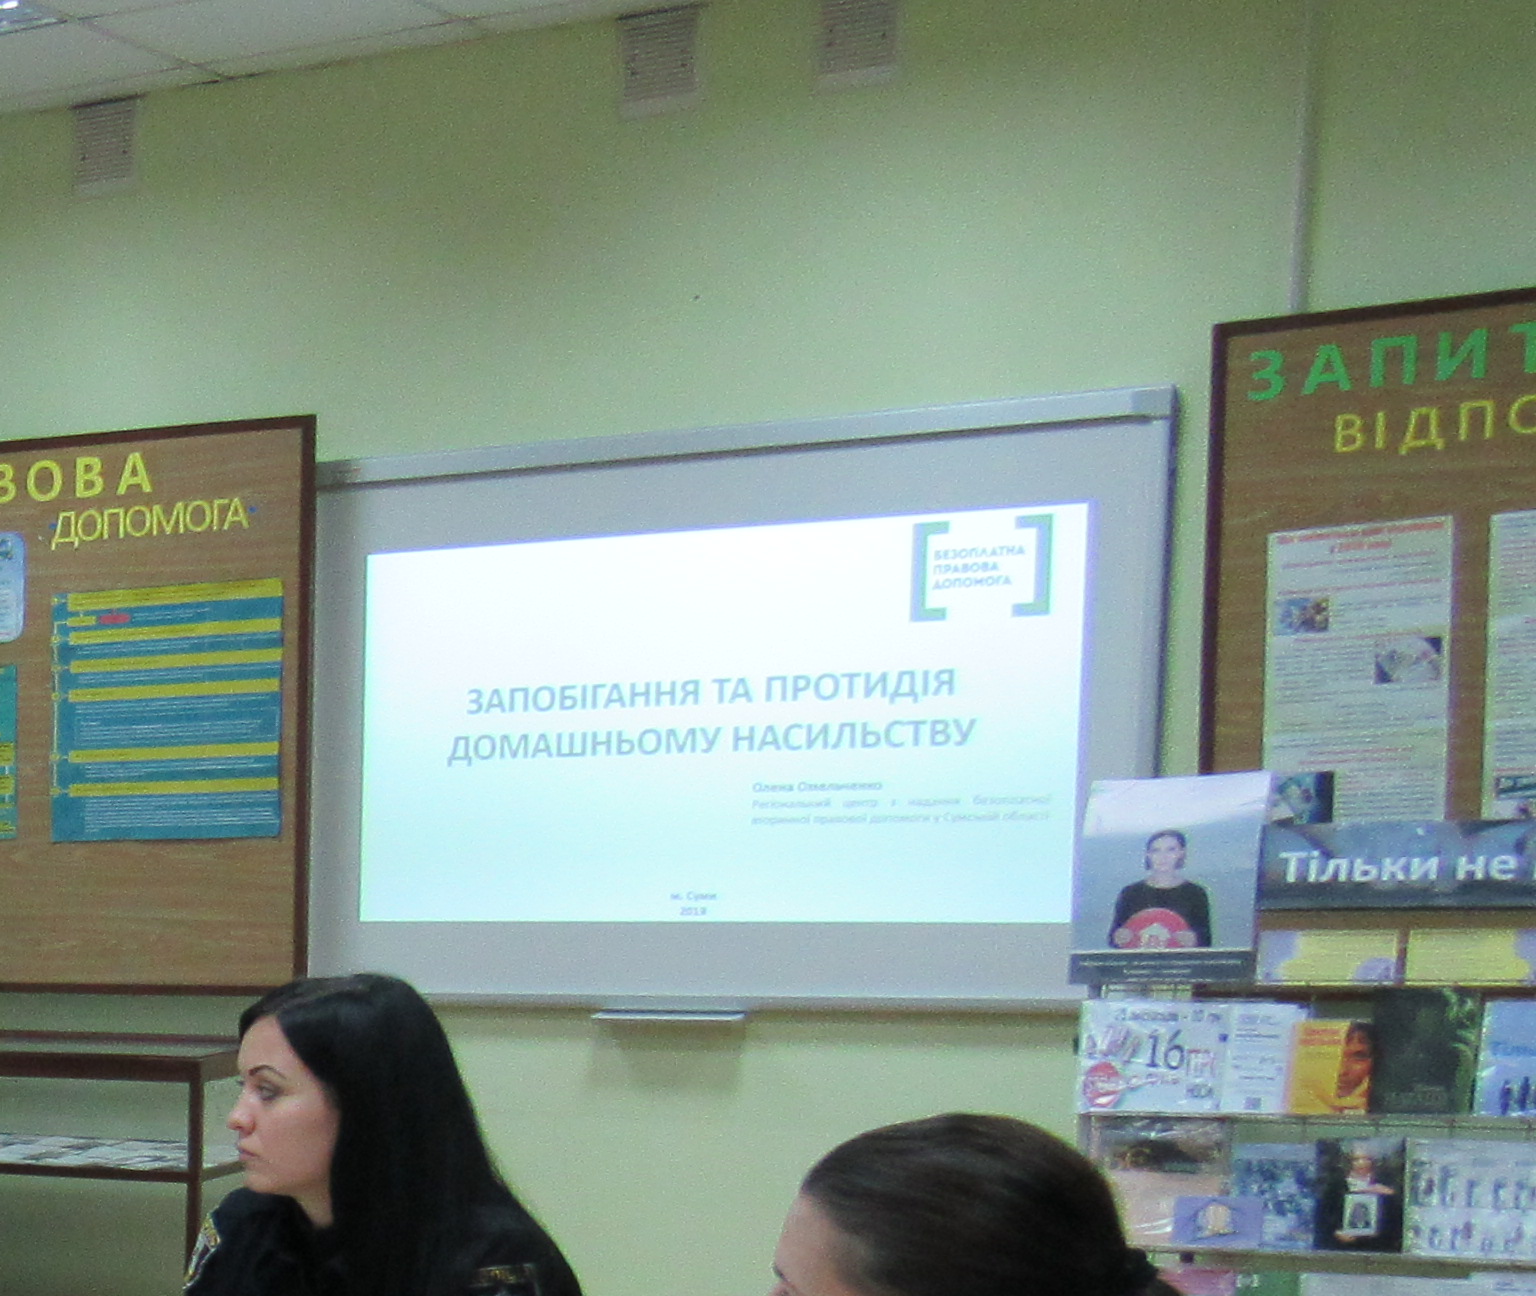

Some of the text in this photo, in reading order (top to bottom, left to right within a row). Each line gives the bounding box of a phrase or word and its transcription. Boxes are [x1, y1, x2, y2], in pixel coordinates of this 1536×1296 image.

[51, 498, 250, 550] ДОПОМОГА
[934, 545, 1026, 560] БЕЗОПЛАТНА
[934, 562, 999, 575] ПРАВОВА
[932, 575, 1012, 590] ДОПОМОГА
[467, 669, 955, 715] ЗАПОБІГАННЯ ТА ПРОТИДІЯ
[447, 718, 977, 767] ДОМАШНЬОМУ НАСИЛЬСТВУ
[1280, 850, 1519, 883] Тільки не
[1145, 1028, 1185, 1070] 16
